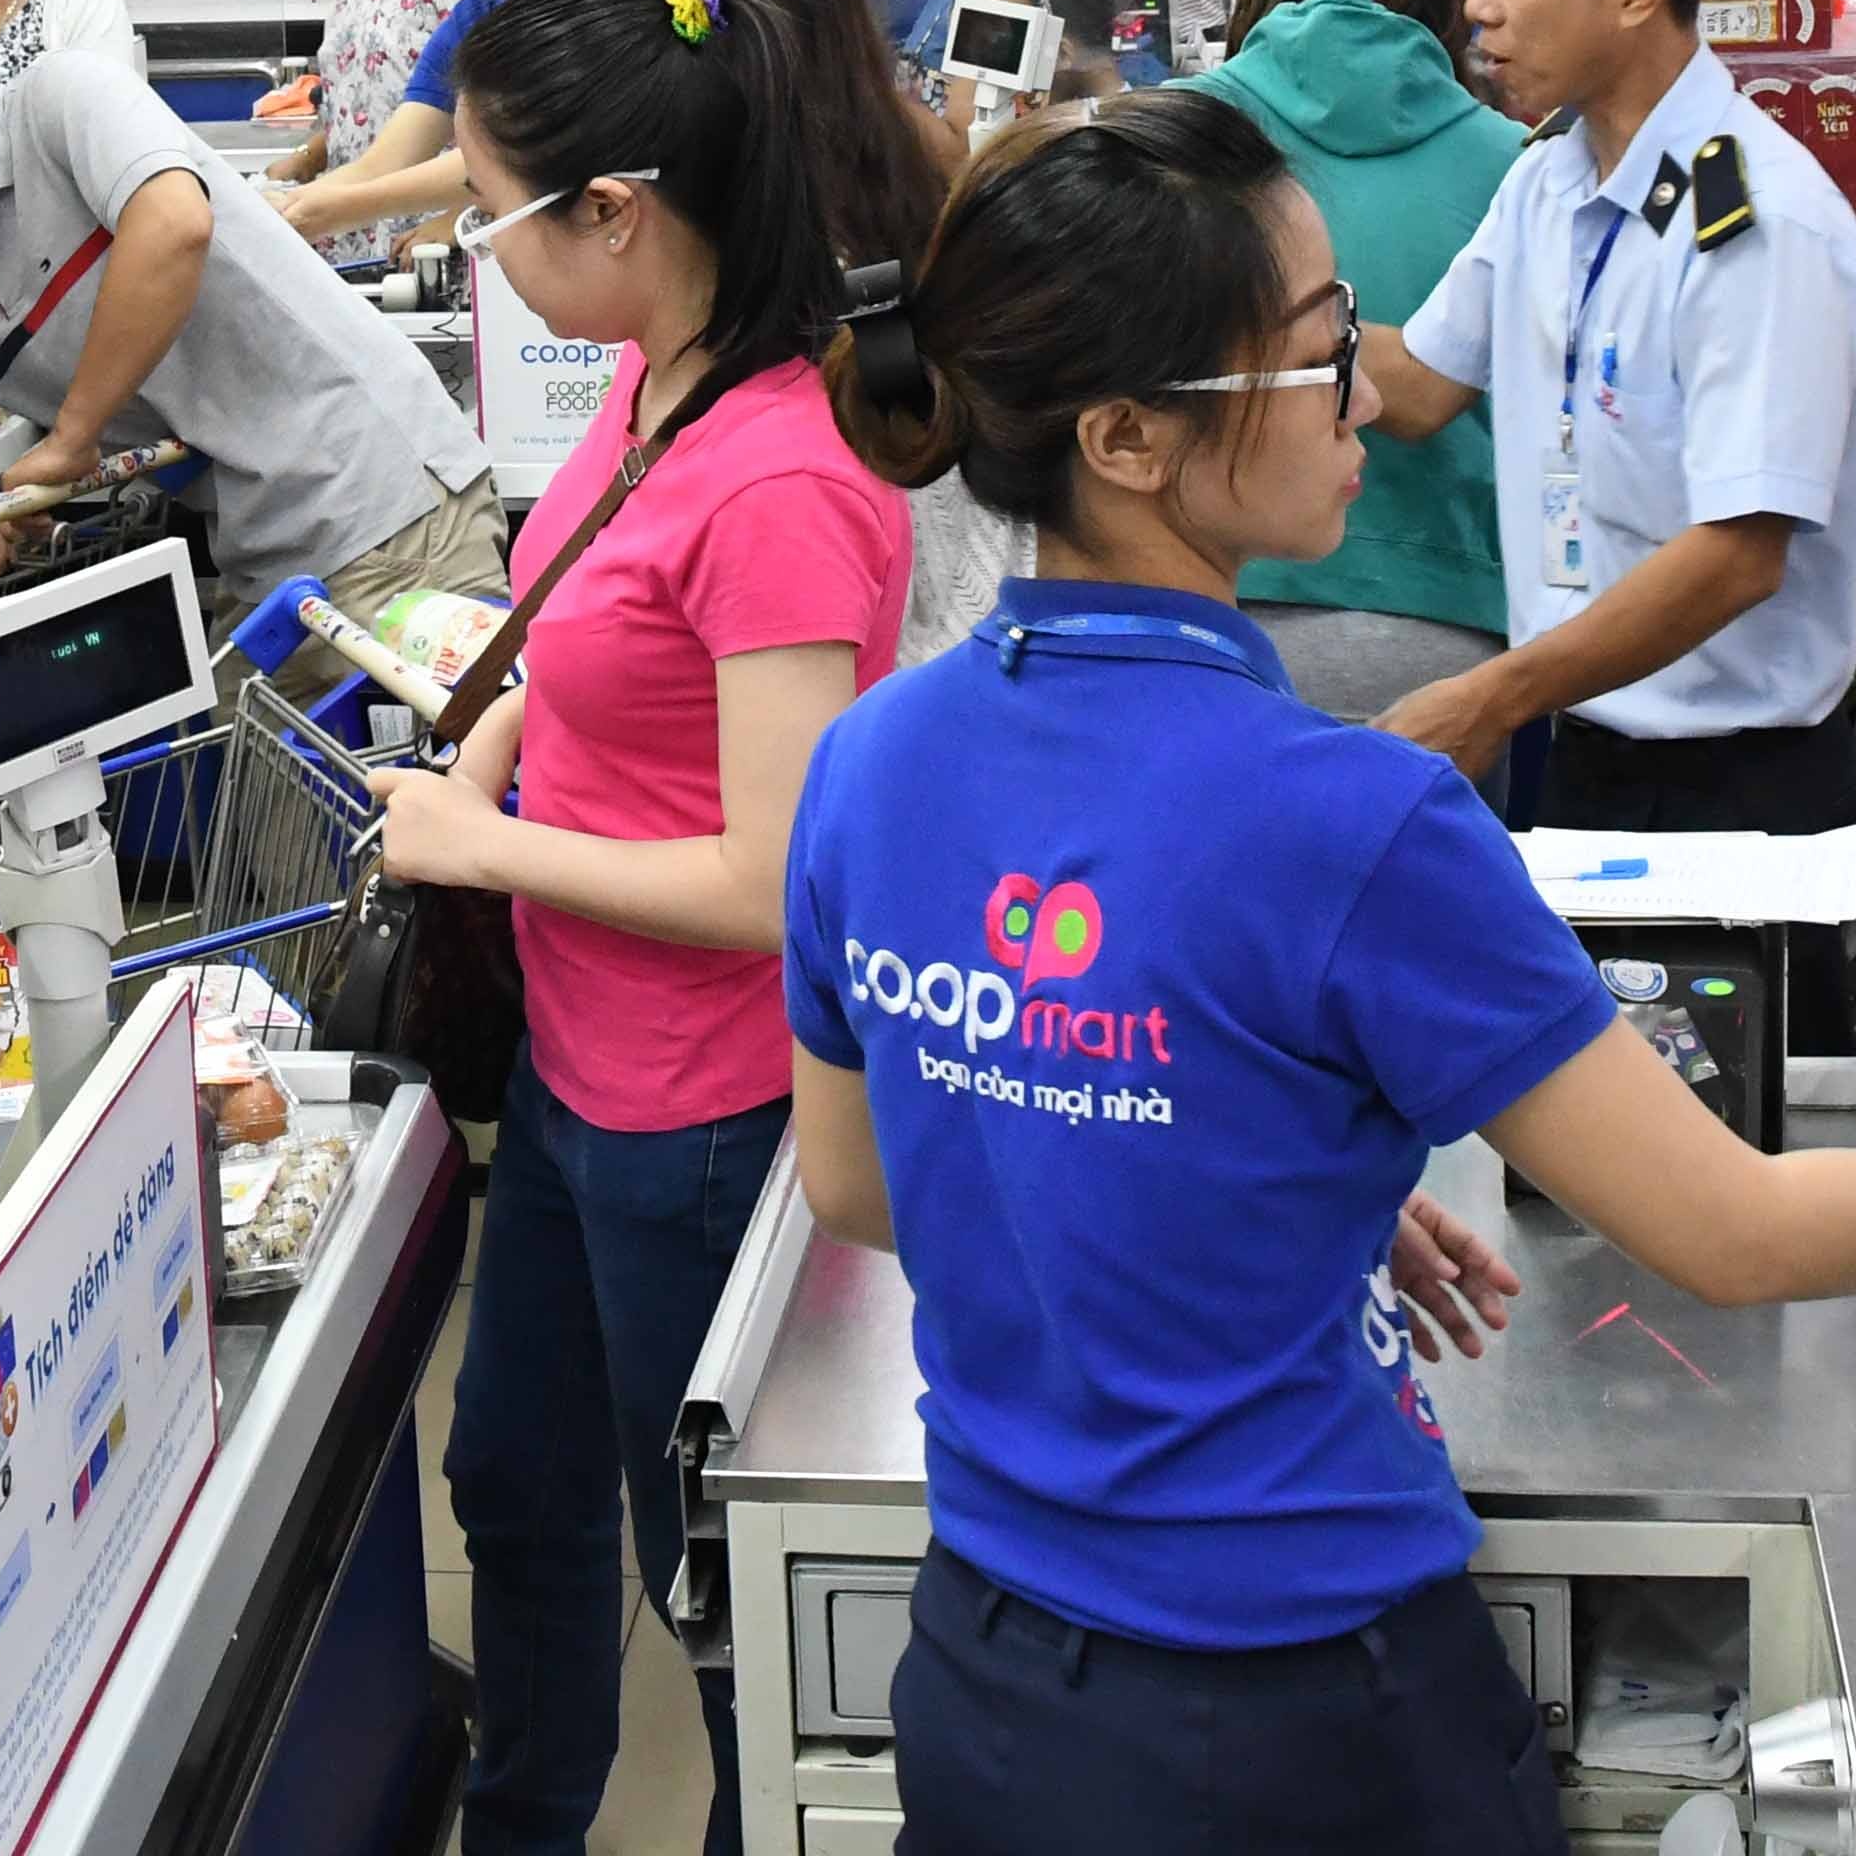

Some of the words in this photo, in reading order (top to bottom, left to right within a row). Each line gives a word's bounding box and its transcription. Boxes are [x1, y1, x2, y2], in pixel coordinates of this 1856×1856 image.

[546, 396, 599, 412] FOOD
[917, 1047, 972, 1095] bạn
[973, 1059, 1026, 1108] của
[1032, 1084, 1093, 1125] mọi
[1101, 1085, 1173, 1126] nhà
[24, 1321, 65, 1408] Tích
[66, 1249, 111, 1338] điểm
[112, 1194, 135, 1265] dễ
[136, 1146, 176, 1227] dàng
